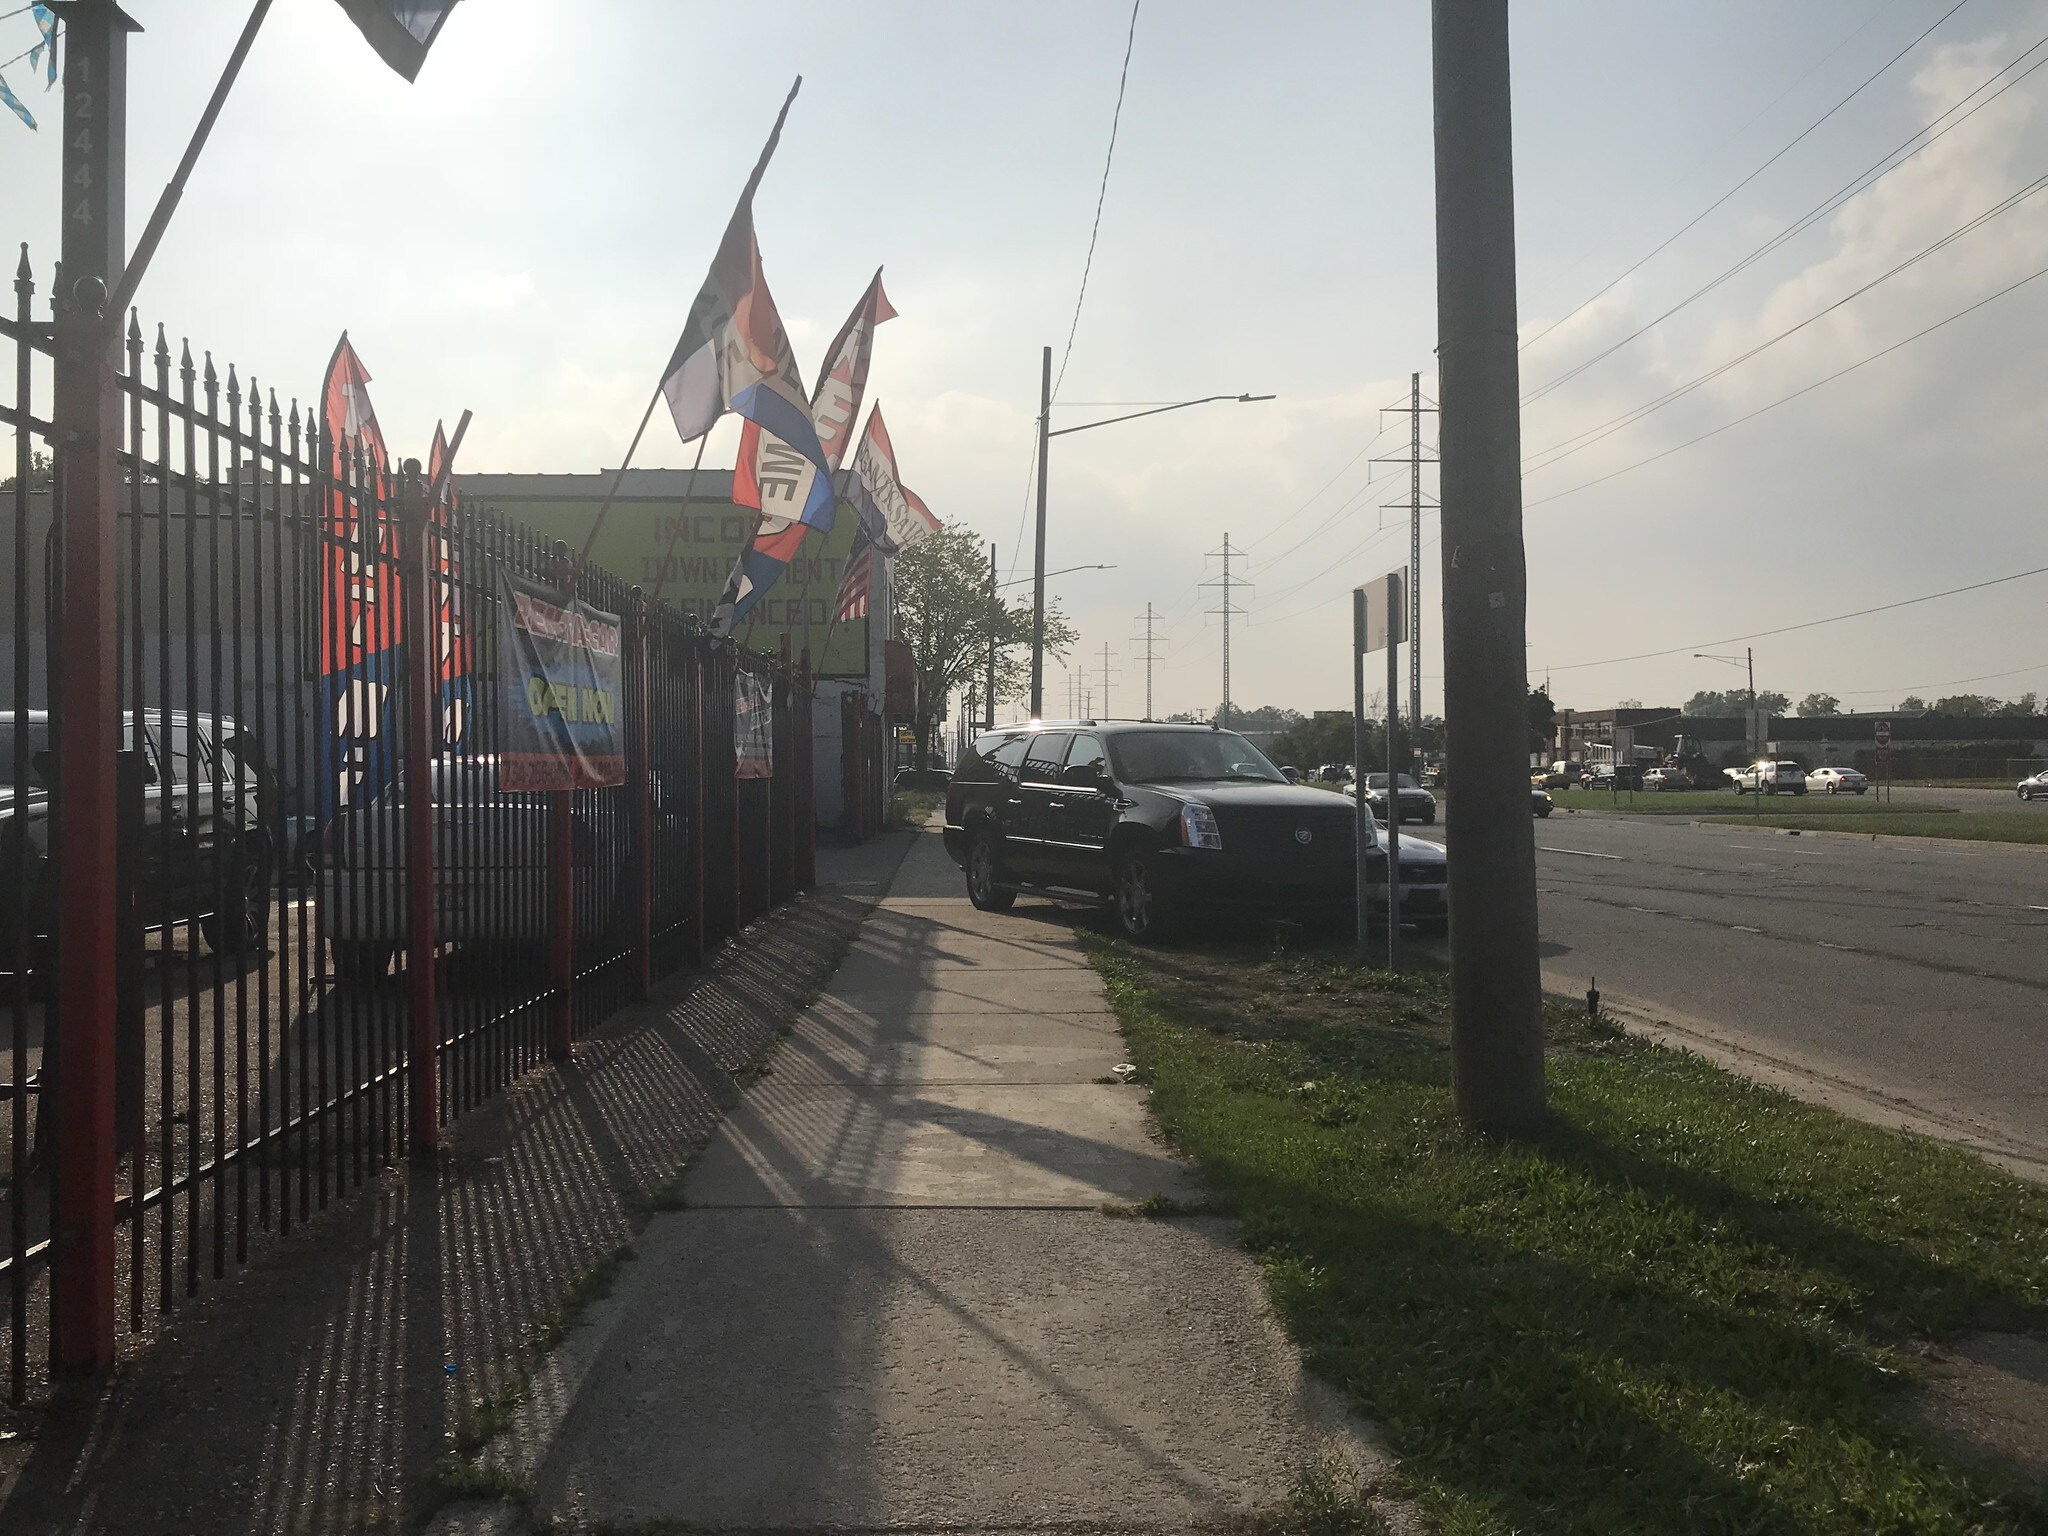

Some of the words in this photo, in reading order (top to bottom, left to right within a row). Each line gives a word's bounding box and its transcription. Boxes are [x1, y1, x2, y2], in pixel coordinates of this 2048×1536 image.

[72, 57, 94, 225] 12444
[642, 557, 718, 584] DOWN
[582, 688, 615, 724] NOW
